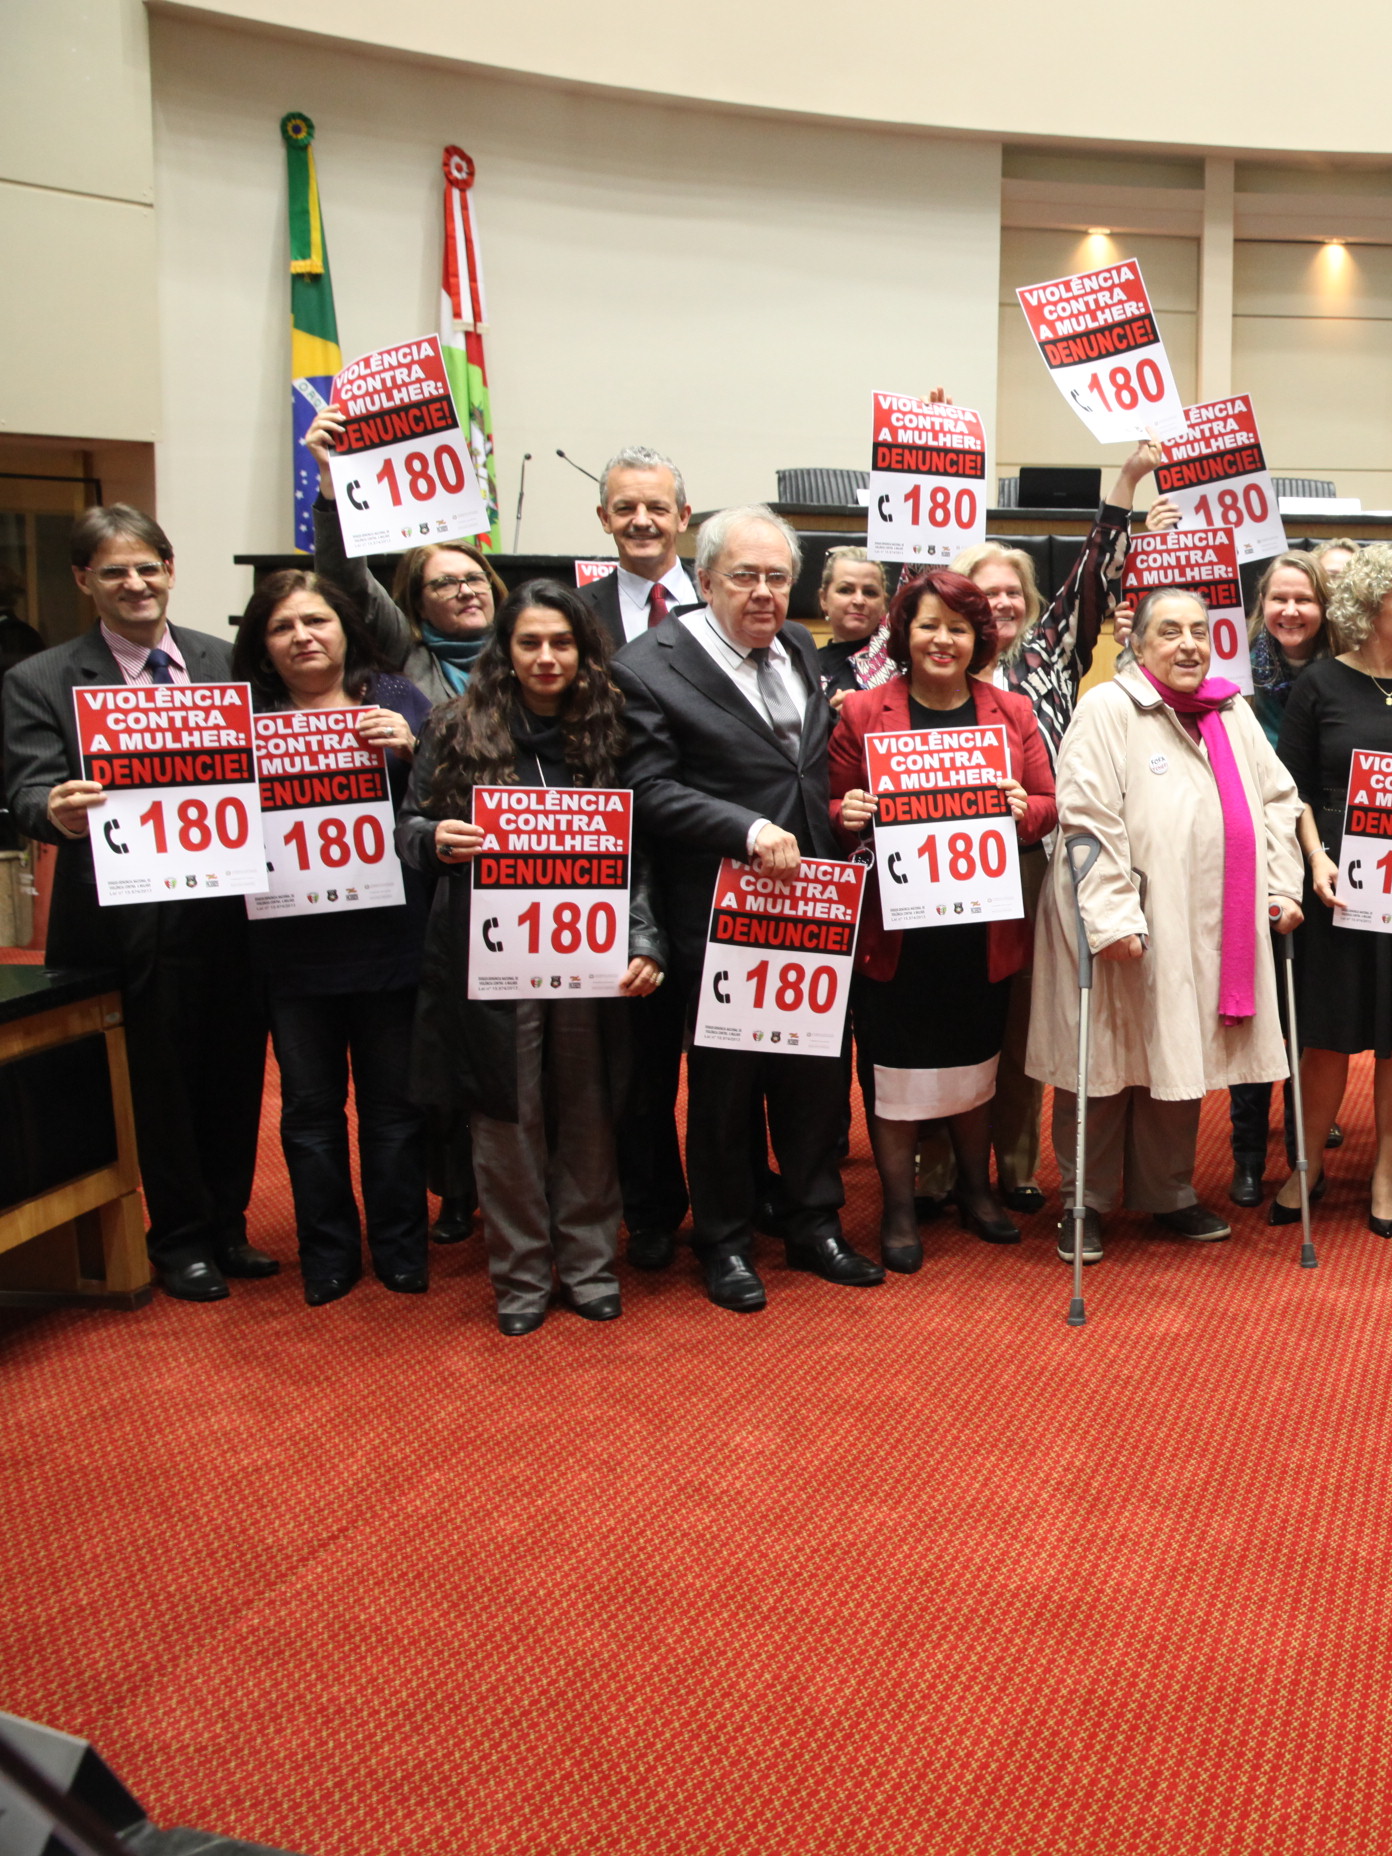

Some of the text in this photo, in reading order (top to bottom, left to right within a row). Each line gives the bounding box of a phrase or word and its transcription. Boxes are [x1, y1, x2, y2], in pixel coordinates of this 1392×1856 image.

[1024, 266, 1135, 307] VIOLÊNCIA
[1039, 301, 1146, 340] A MULHER:
[1043, 287, 1127, 321] CONTRA
[1044, 318, 1154, 366] DENUNCIE!
[336, 341, 435, 389] VIOLÊNCIA
[340, 364, 426, 399] CONTRA
[347, 379, 444, 417] MULHER:
[1088, 357, 1165, 412] 180
[332, 400, 453, 452] DENUNCIE!
[878, 428, 981, 450] A MULHER:
[890, 412, 968, 434] CONTRA
[877, 446, 981, 476] DENUNCIE!
[1171, 431, 1255, 463] MULHER:
[376, 443, 465, 507] 180
[1158, 448, 1262, 490] DENUNCIE!
[903, 484, 977, 530] 180
[1194, 482, 1269, 529] 180
[1125, 564, 1234, 587] A MULHER:
[1136, 549, 1218, 569] CONTRA
[83, 687, 242, 710] VIOLÊNCIA
[106, 709, 226, 731] CONTRA
[89, 729, 246, 752] A MULHER:
[254, 732, 359, 756] CONTRA
[873, 730, 999, 754] VIOLÊNCIA
[91, 753, 249, 786] DENUNCIE!
[261, 750, 379, 775] MULHER:
[890, 750, 986, 772] CONTRA
[260, 773, 383, 807] ENUNCIE!
[877, 768, 1003, 792] A MULHER:
[481, 789, 624, 812] VIOLÊNCIA
[880, 789, 1007, 823] DENUNCIE!
[1353, 790, 1369, 805] A
[139, 796, 249, 854] 180
[499, 813, 607, 832] CONTRA
[283, 814, 385, 871] 180
[481, 833, 623, 852] A MULHER:
[917, 829, 1007, 883] 180
[480, 858, 623, 885] DENUNCIE!
[739, 875, 839, 900] CONTRA
[720, 892, 853, 921] A MULHER:
[517, 901, 617, 954] 180
[716, 914, 850, 951] DENUNCIE!
[746, 959, 838, 1014] 180
